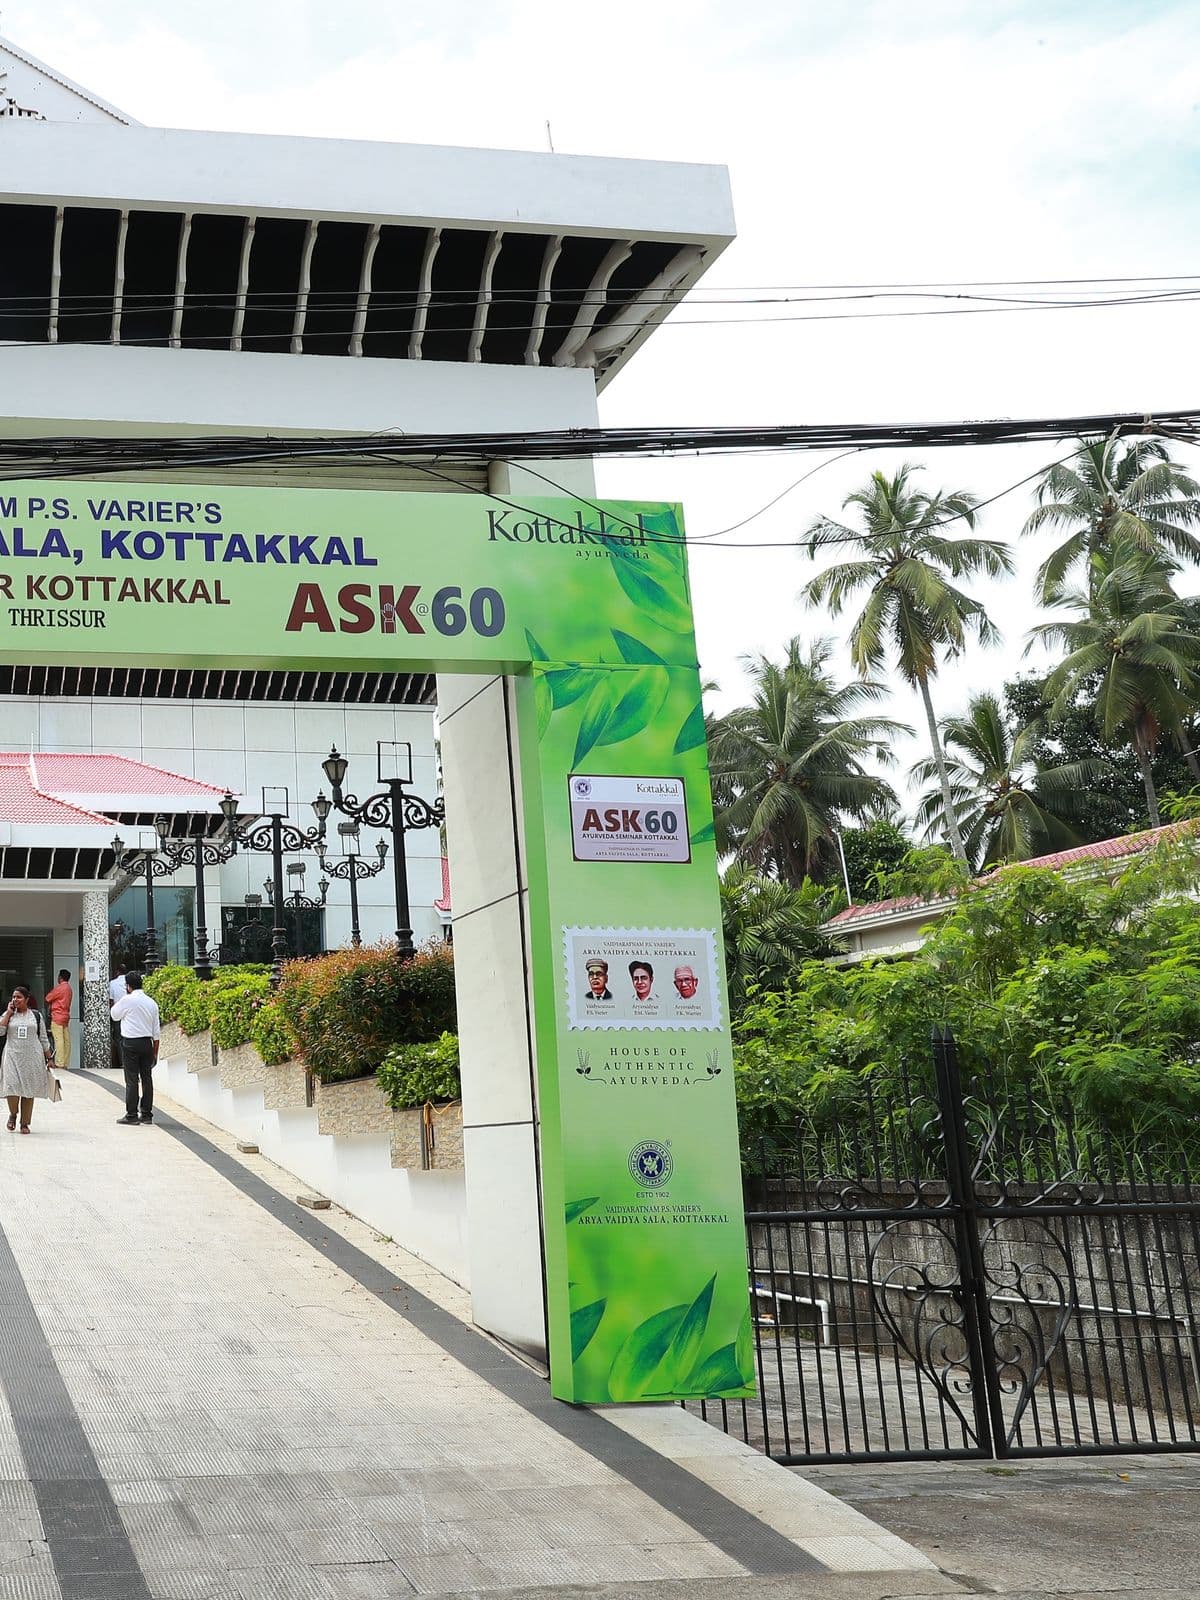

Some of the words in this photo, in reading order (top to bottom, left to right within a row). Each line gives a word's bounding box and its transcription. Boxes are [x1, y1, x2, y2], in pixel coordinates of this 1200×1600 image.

[28, 499, 78, 520] P.S.
[87, 500, 222, 524] VARIER'S
[486, 510, 648, 547] Kottakkal
[101, 530, 378, 566] KOTTAKKAL
[26, 575, 231, 605] KOTTAKKAL
[8, 608, 106, 629] THRISSUR
[636, 783, 679, 794] Kottakkal
[610, 1048, 660, 1056] HOUSE
[669, 1048, 688, 1056] OF
[604, 1062, 695, 1070] AUTHENTIC
[610, 1076, 690, 1085] AYURVEDA
[605, 1205, 660, 1214] VAIDYARATNAM
[578, 1216, 601, 1225] ARYA
[604, 1215, 640, 1225] VAIDYA
[643, 1215, 670, 1225] SALA,
[673, 1214, 730, 1224] KOTTAKKAL
